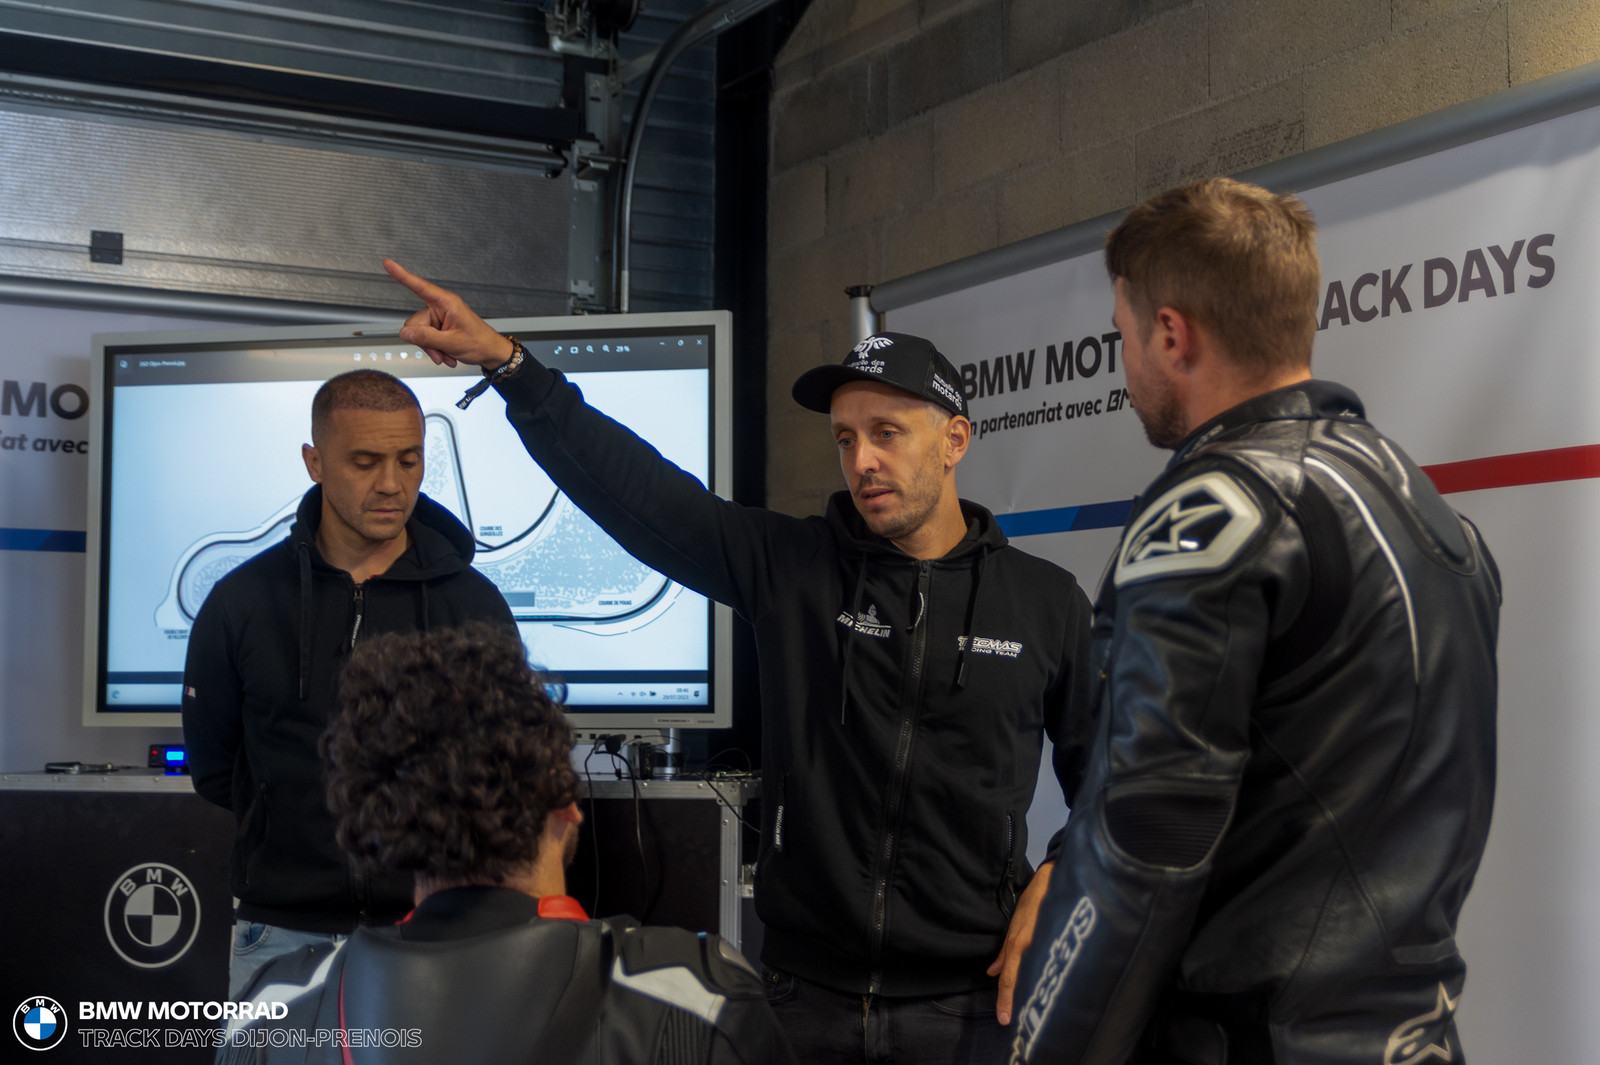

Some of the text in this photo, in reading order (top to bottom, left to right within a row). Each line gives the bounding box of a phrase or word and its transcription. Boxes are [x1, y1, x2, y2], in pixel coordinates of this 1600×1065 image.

[960, 233, 1556, 401] BMW MOT ACK DAYS
[1, 379, 90, 420] MO
[932, 380, 963, 411] motards
[979, 401, 1063, 440] partenariat
[1065, 397, 1102, 420] avec
[0, 433, 89, 454] at avec
[836, 613, 892, 638] MICHELIN
[994, 649, 1018, 658] TEAM
[119, 868, 189, 897] BMW
